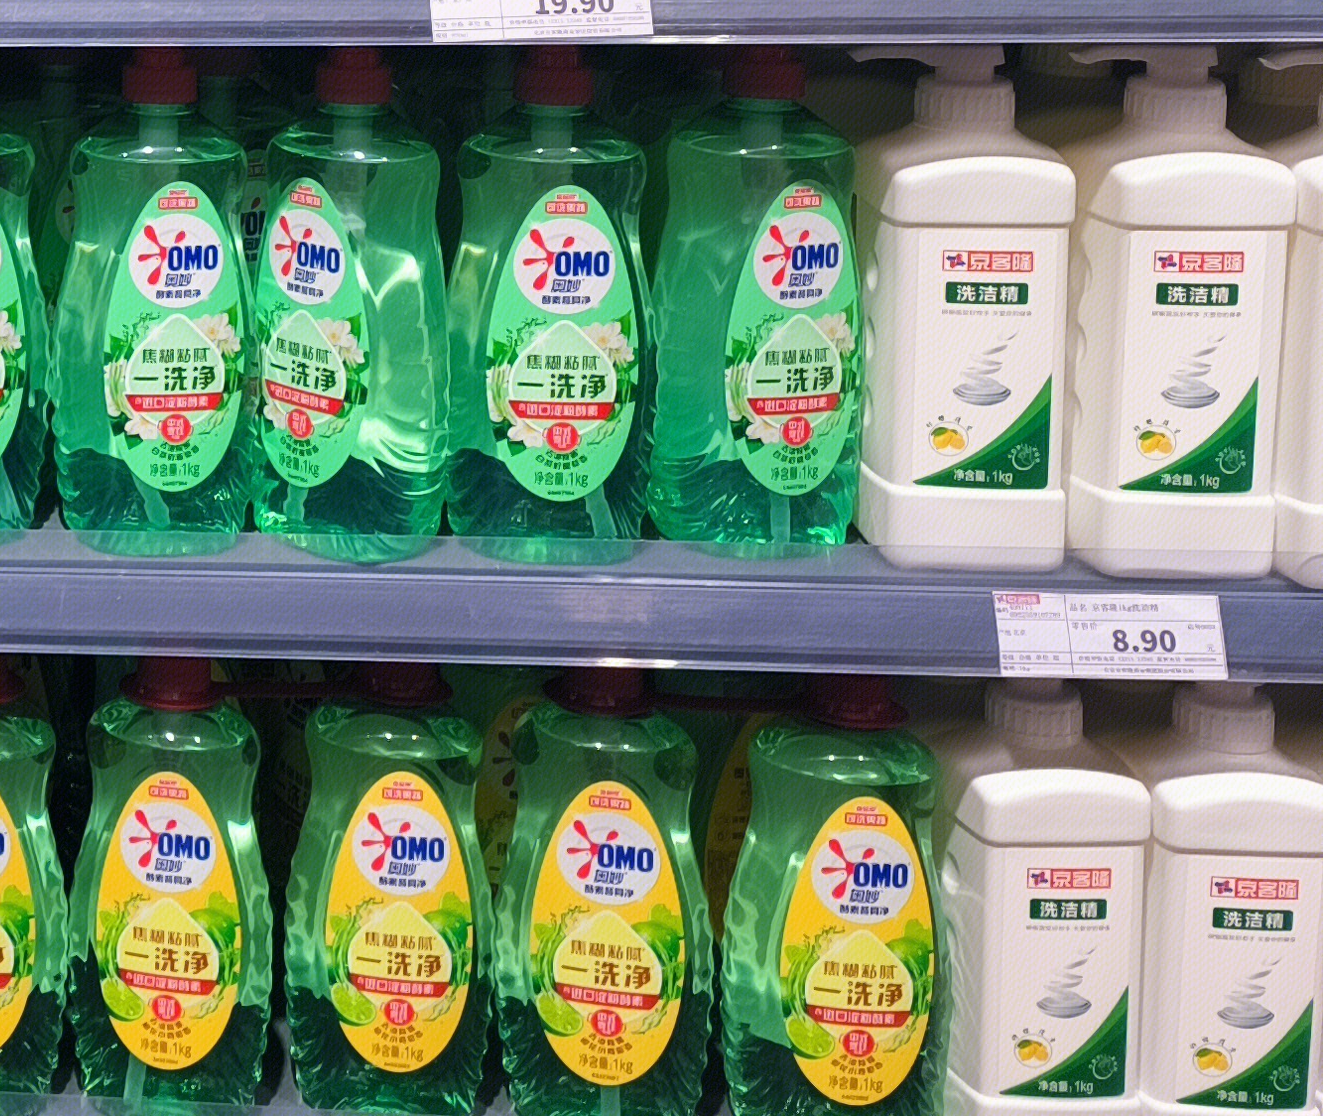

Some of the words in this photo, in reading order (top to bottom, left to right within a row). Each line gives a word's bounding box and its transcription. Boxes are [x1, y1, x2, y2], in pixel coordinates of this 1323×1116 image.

[167, 244, 218, 270] OMO
[791, 242, 839, 270] OMO
[970, 253, 1033, 270] 京客隆
[956, 285, 1018, 302] 洗洁精
[1113, 629, 1176, 652] 8.90
[391, 835, 444, 862] OMO
[853, 862, 908, 888] OMO
[1053, 871, 1111, 887] 京客隆
[1237, 881, 1299, 898] 京客隆
[1040, 901, 1098, 919] 洗洁精
[1223, 911, 1284, 929] 洗洁精
[814, 982, 903, 1007] 一洗净
